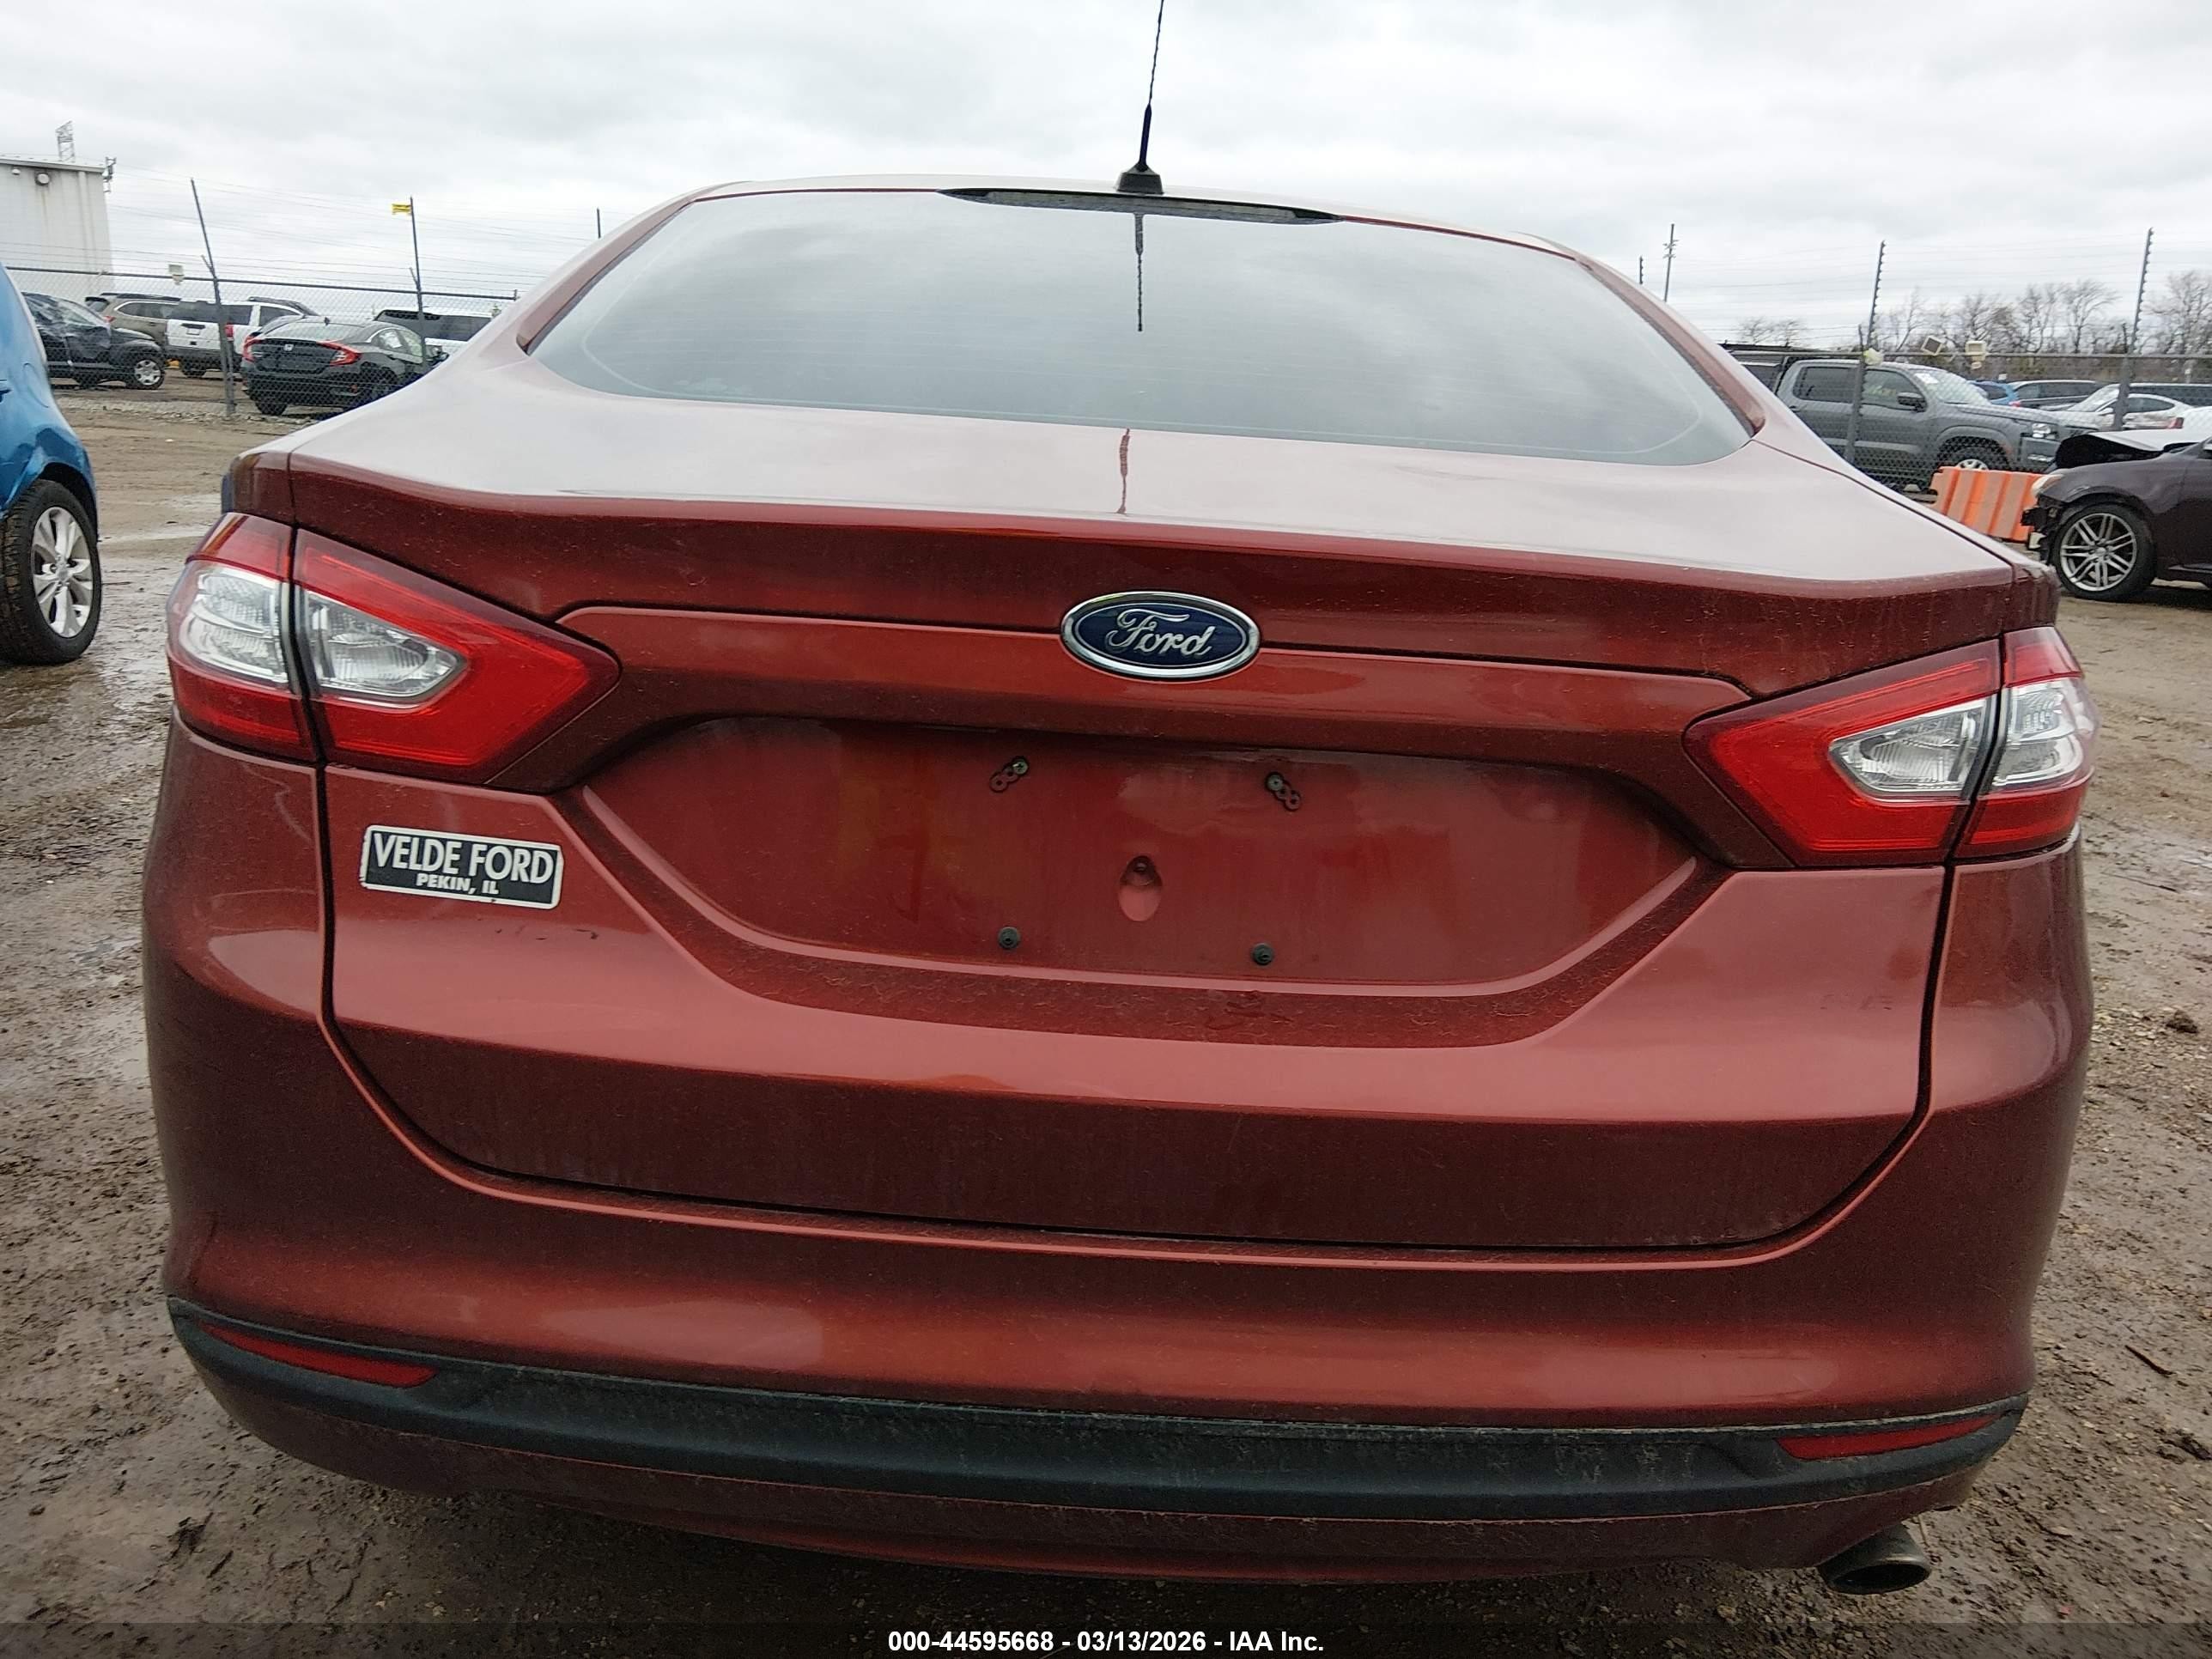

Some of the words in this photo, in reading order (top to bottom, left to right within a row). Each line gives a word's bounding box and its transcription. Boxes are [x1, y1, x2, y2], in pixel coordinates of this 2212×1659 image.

[1106, 608, 1216, 655] Ford
[374, 832, 462, 874] VELDE
[469, 843, 554, 884] FORD
[416, 872, 477, 895] PEKIN,
[481, 879, 500, 895] IL
